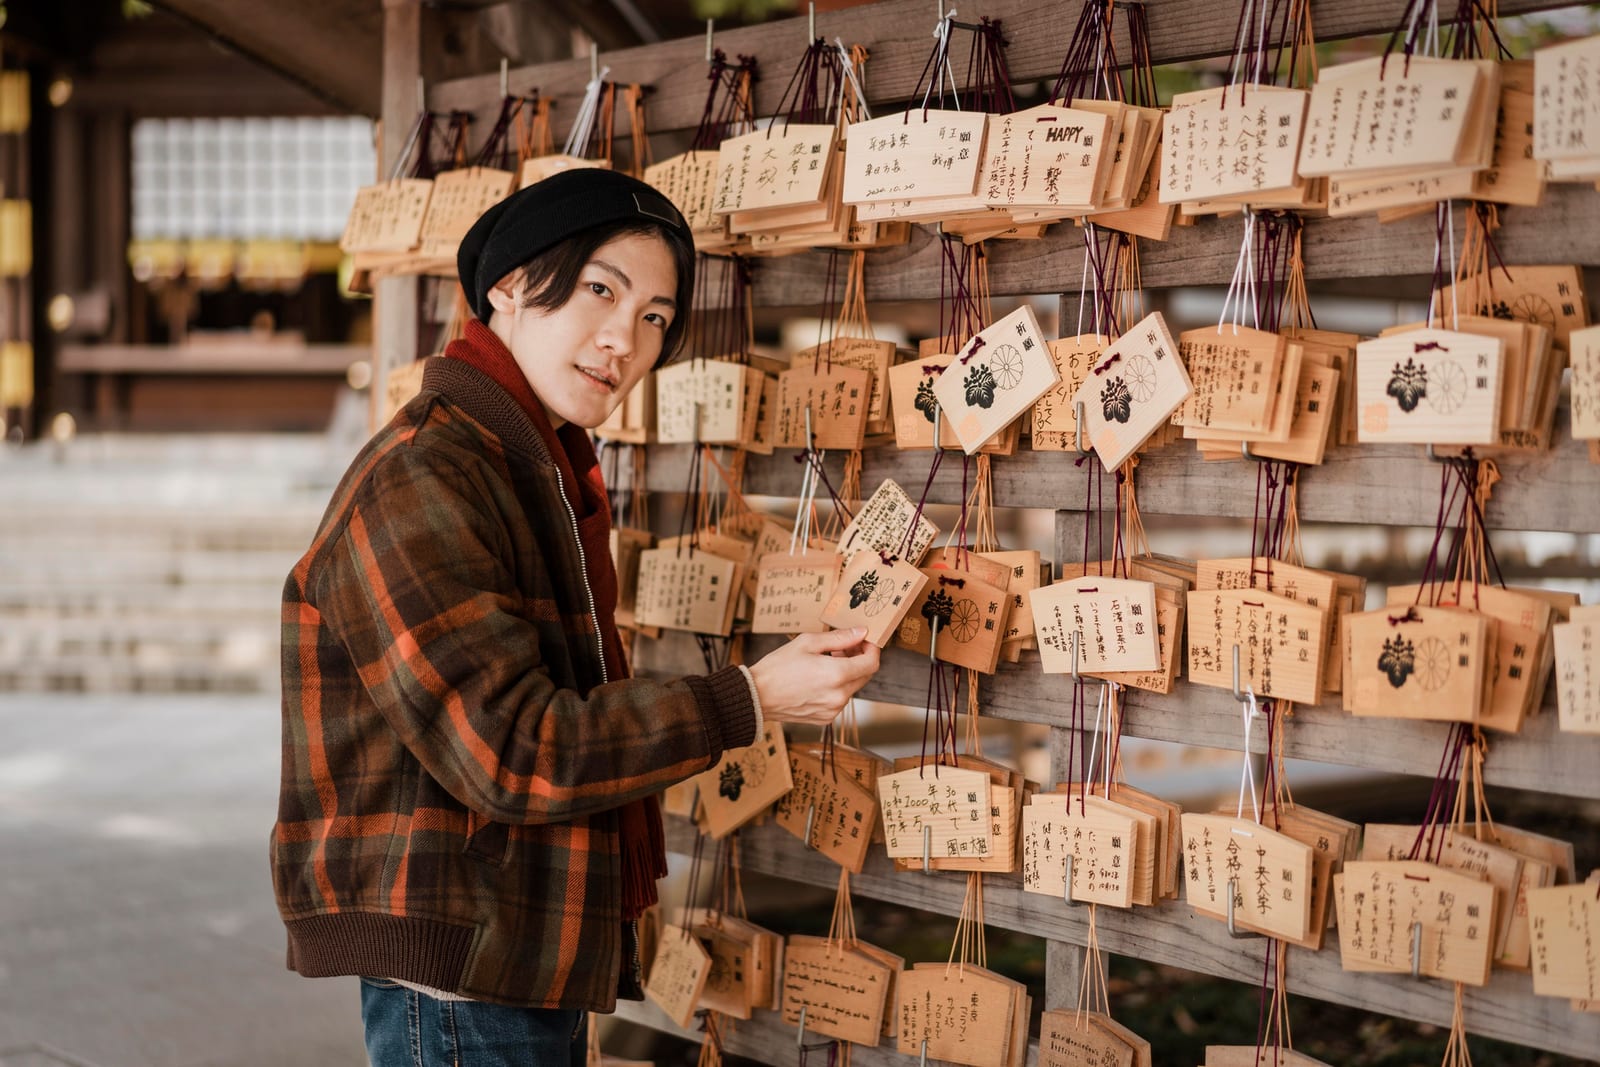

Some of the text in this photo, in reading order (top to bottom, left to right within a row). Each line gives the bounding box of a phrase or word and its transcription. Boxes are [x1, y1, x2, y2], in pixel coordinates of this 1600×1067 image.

[1045, 126, 1084, 144] HAPPY
[1015, 321, 1036, 353] 祈願
[1146, 329, 1167, 361] 祈願
[984, 600, 998, 631] 祈願
[1131, 603, 1146, 635] 願意
[967, 791, 980, 822] 願意
[991, 806, 1001, 836] 願意
[1042, 822, 1052, 863] 健康で
[1111, 836, 1122, 868] 願意
[1255, 844, 1272, 915] 中央大学
[1281, 867, 1293, 902] 願意
